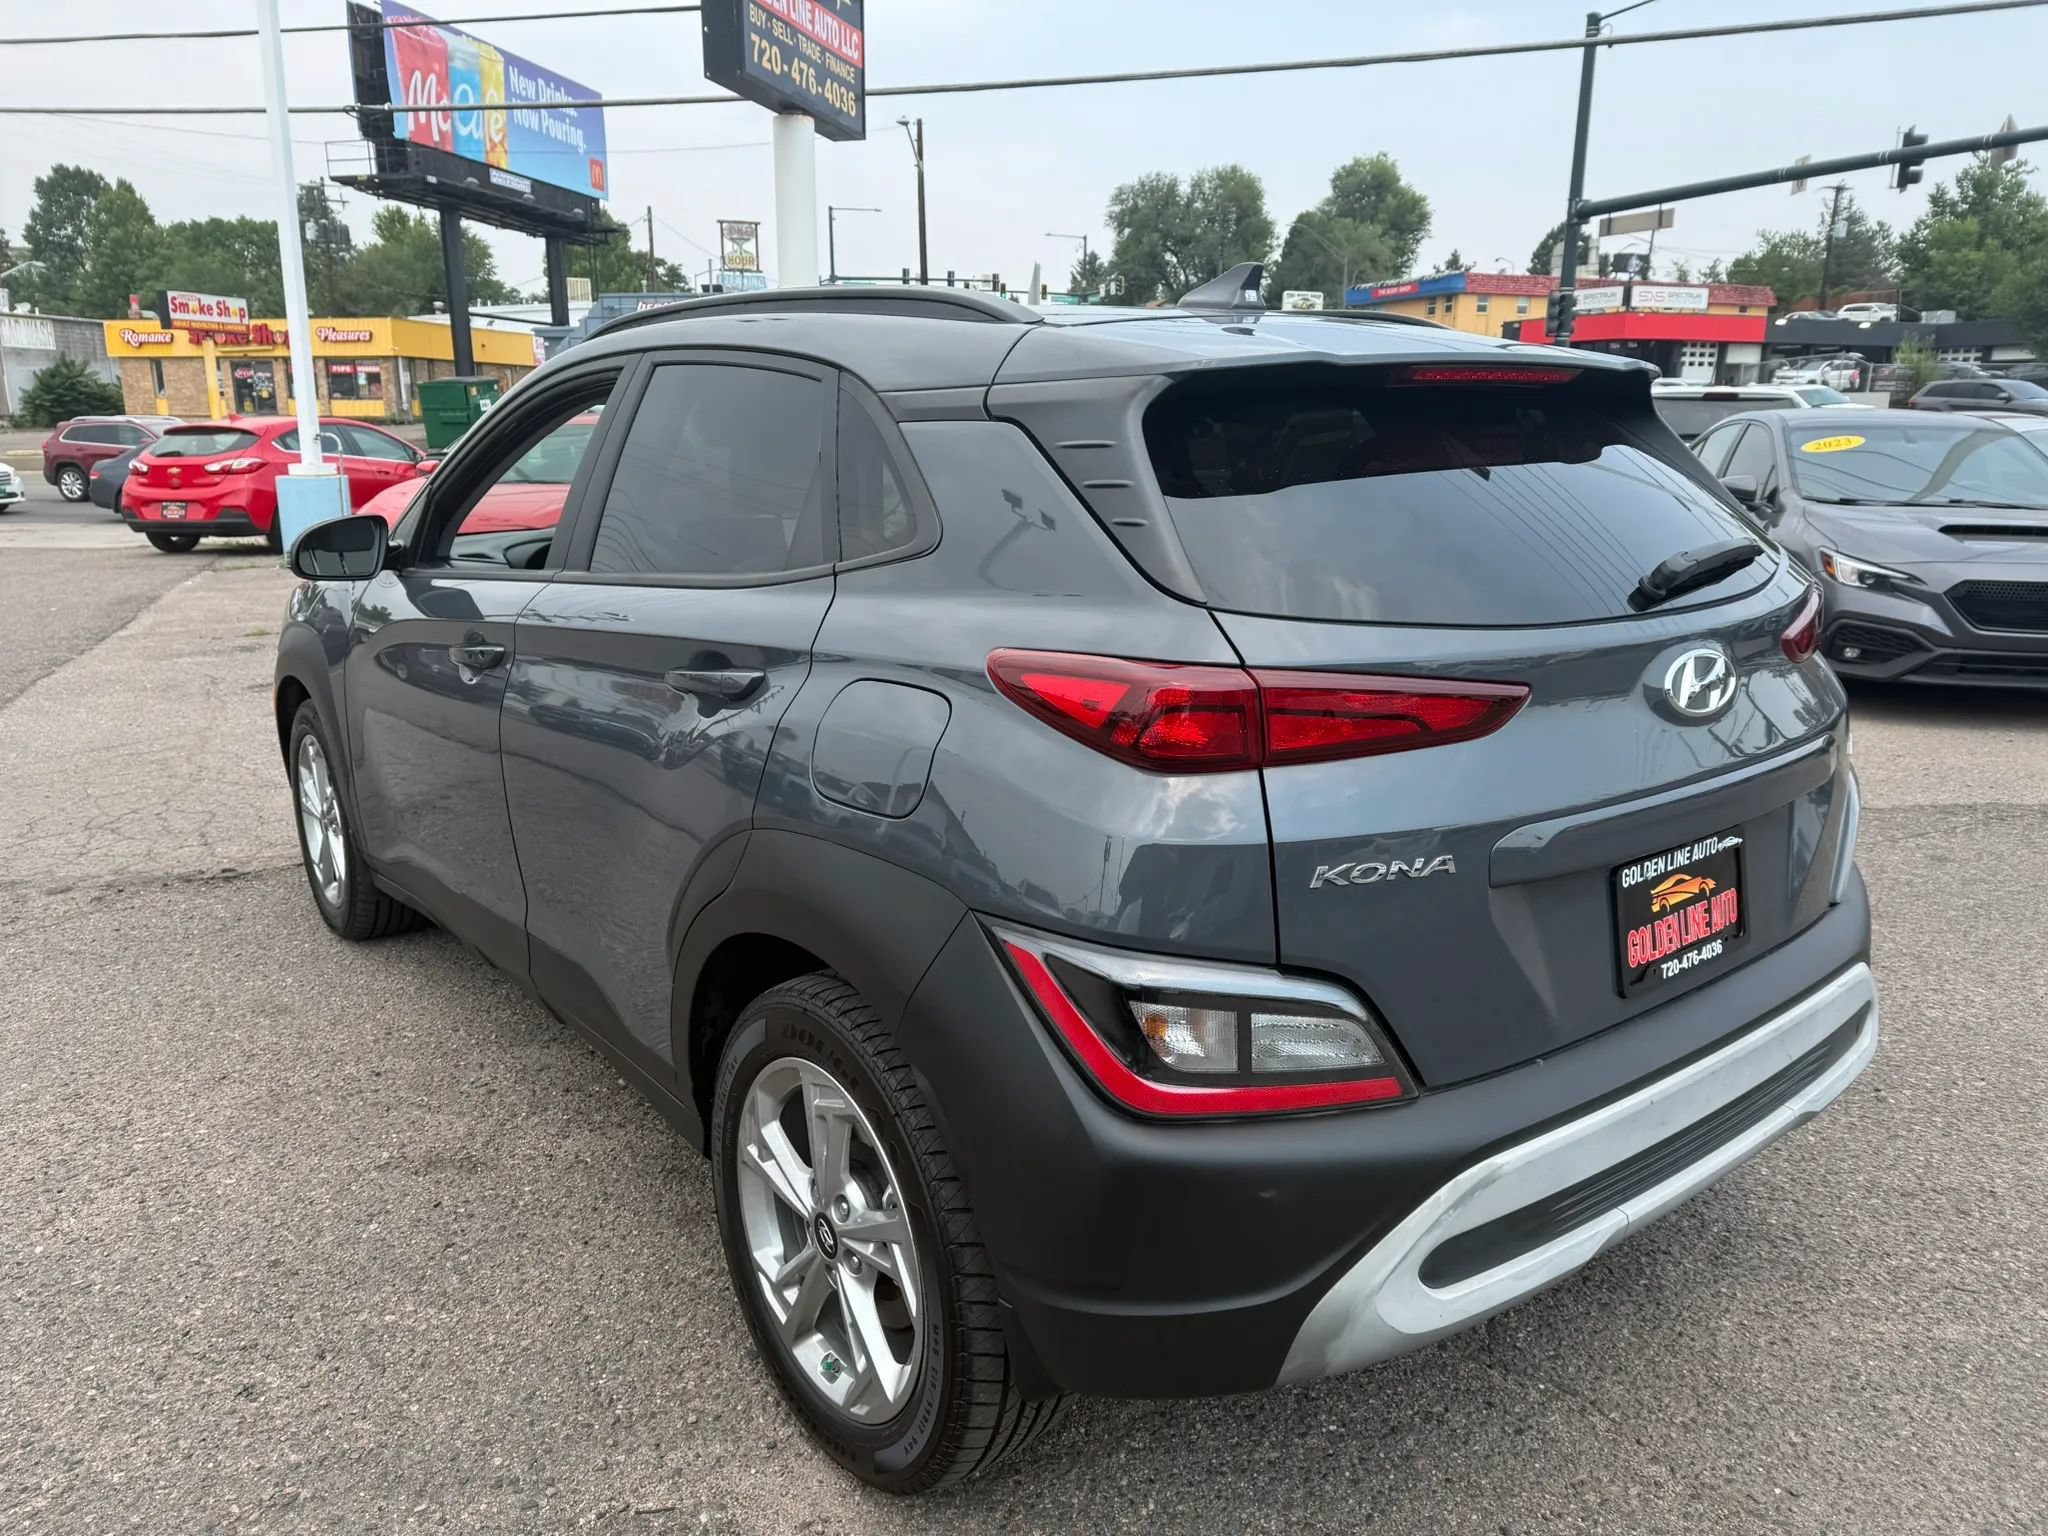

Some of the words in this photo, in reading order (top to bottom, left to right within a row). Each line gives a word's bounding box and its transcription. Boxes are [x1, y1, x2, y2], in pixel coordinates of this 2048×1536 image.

[749, 3, 766, 29] BUY
[772, 18, 793, 46] SELL
[797, 33, 822, 64] TRADE
[825, 52, 856, 84] FINANCE
[789, 0, 812, 31] LINE
[814, 8, 839, 48] AUTO
[841, 24, 859, 60] LLC
[508, 65, 536, 100] New
[511, 99, 540, 133] Now
[728, 255, 755, 266] HOUR
[170, 295, 213, 317] Smoke
[215, 299, 246, 323] Shop
[120, 328, 173, 347] Romance
[316, 327, 372, 343] Pleasures
[1813, 437, 1852, 450] 2023
[1309, 854, 1457, 889] KONA
[1622, 855, 1665, 888] GOLDEN
[1667, 845, 1691, 872] LINE
[1692, 836, 1718, 860] AUTO
[1627, 911, 1681, 968] GOLDEN
[1679, 899, 1711, 947] LINE
[1711, 888, 1737, 933] AUTO
[1661, 939, 1723, 979] 720-476-4036
